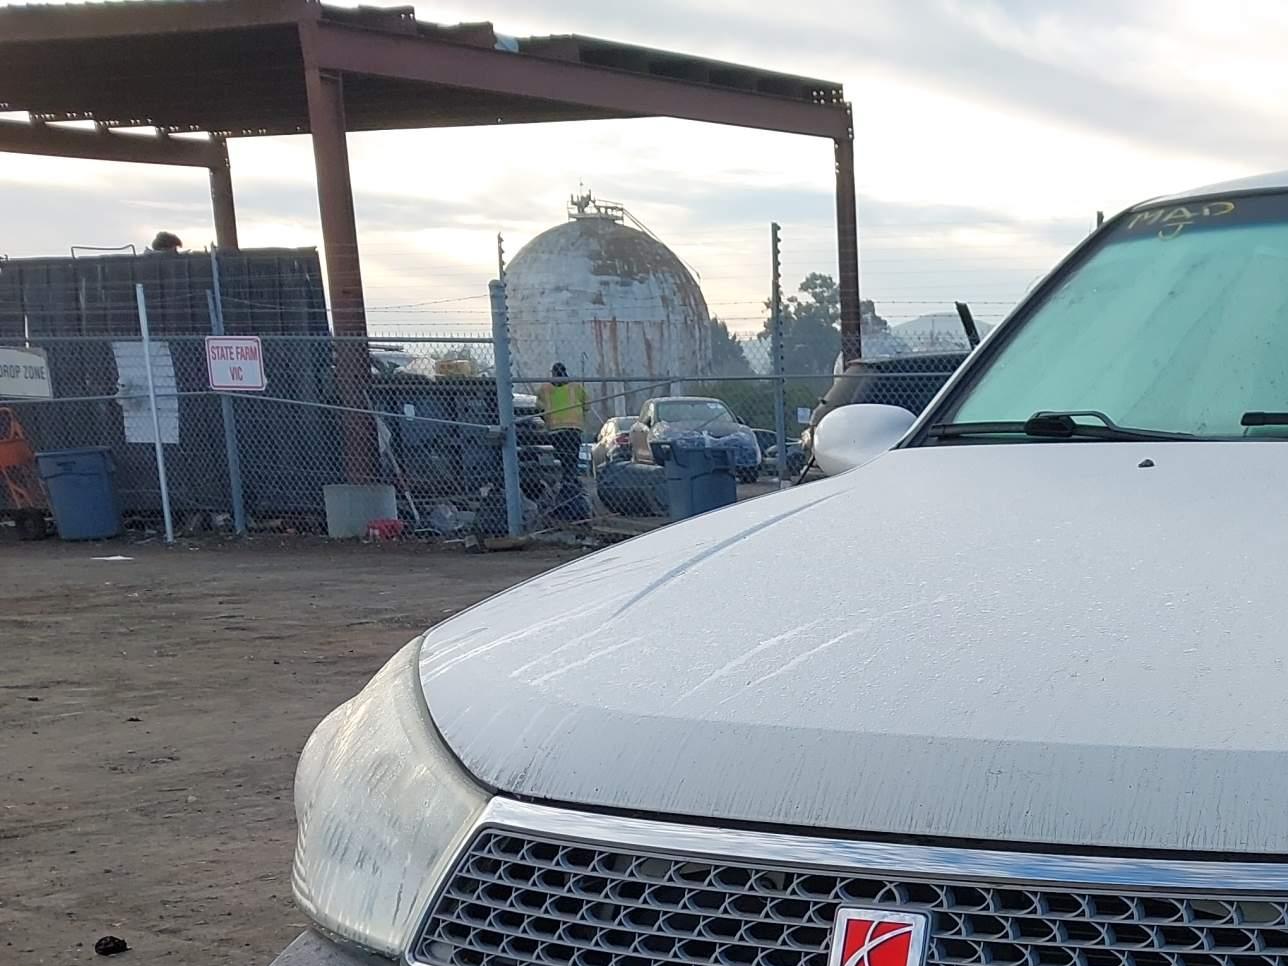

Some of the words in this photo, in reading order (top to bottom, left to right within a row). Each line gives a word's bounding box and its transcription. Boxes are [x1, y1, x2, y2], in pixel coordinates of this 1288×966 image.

[1127, 201, 1235, 229] MAD
[211, 345, 235, 361] STATE
[235, 345, 258, 361] FARM
[22, 364, 46, 380] ZONE
[229, 366, 243, 381] VIC
